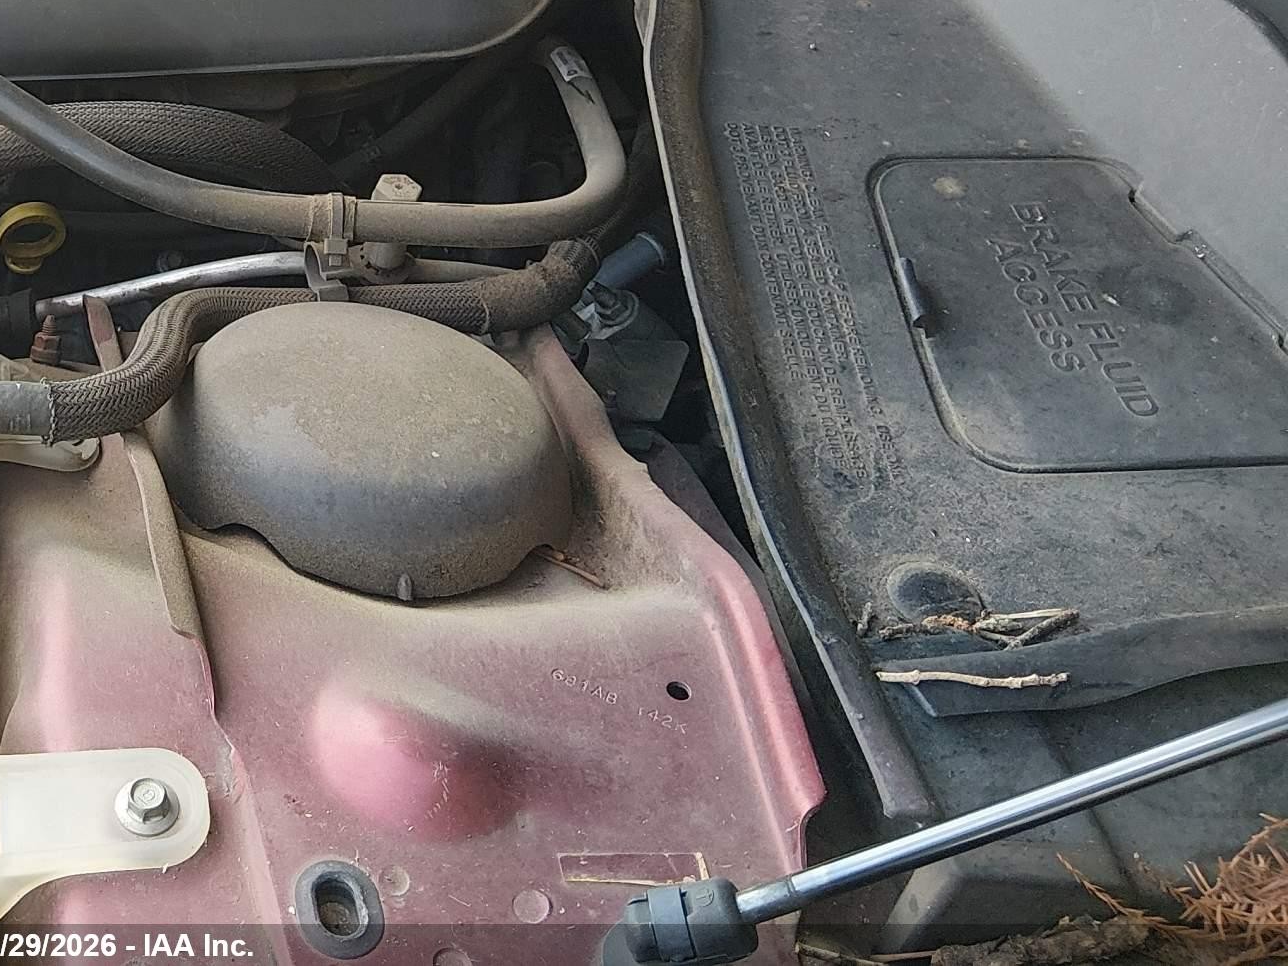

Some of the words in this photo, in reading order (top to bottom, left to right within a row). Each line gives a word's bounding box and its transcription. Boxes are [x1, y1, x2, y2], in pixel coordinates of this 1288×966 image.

[985, 237, 1086, 373] ACCESS
[1010, 202, 1099, 313] BRAKE
[1076, 321, 1160, 417] FLUID
